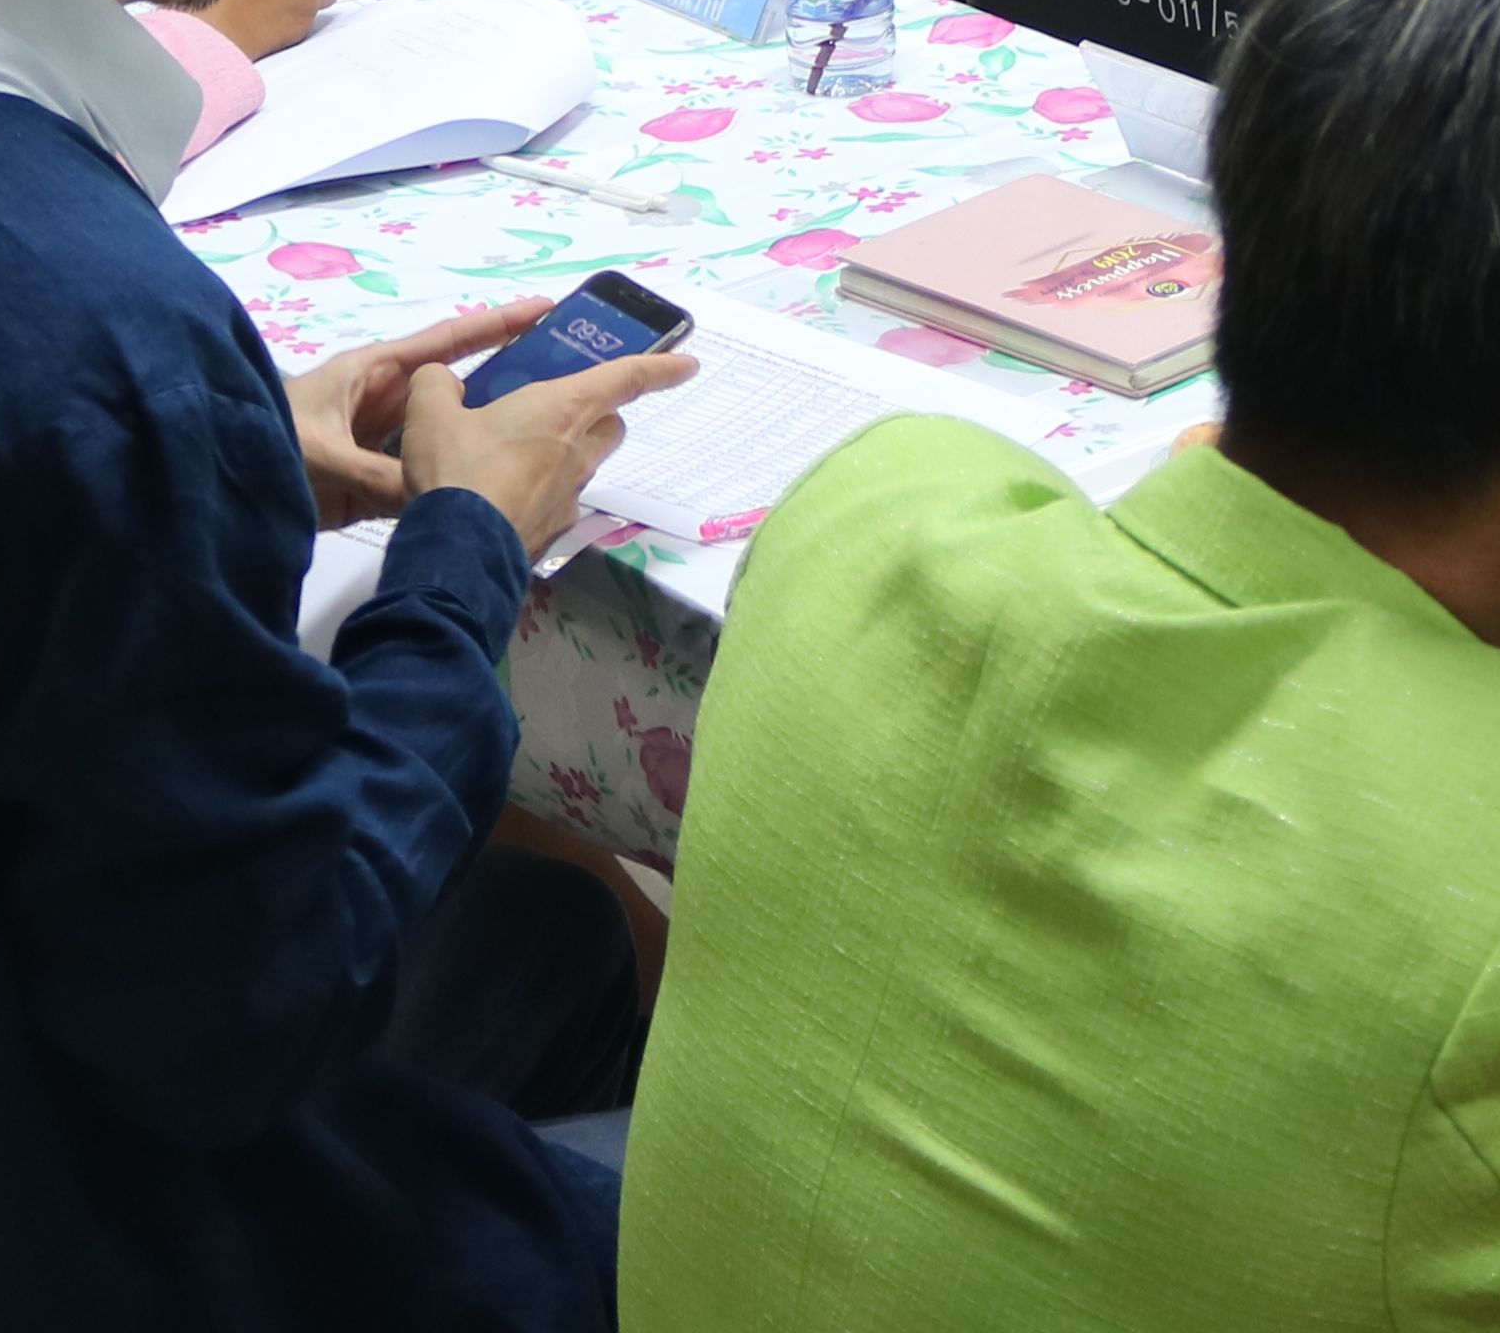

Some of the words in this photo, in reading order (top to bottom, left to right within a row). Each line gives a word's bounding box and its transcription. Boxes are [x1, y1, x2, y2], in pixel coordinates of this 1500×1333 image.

[1056, 248, 1182, 300] Happiness
[1092, 245, 1142, 269] 2019
[567, 317, 624, 353] 09:57
